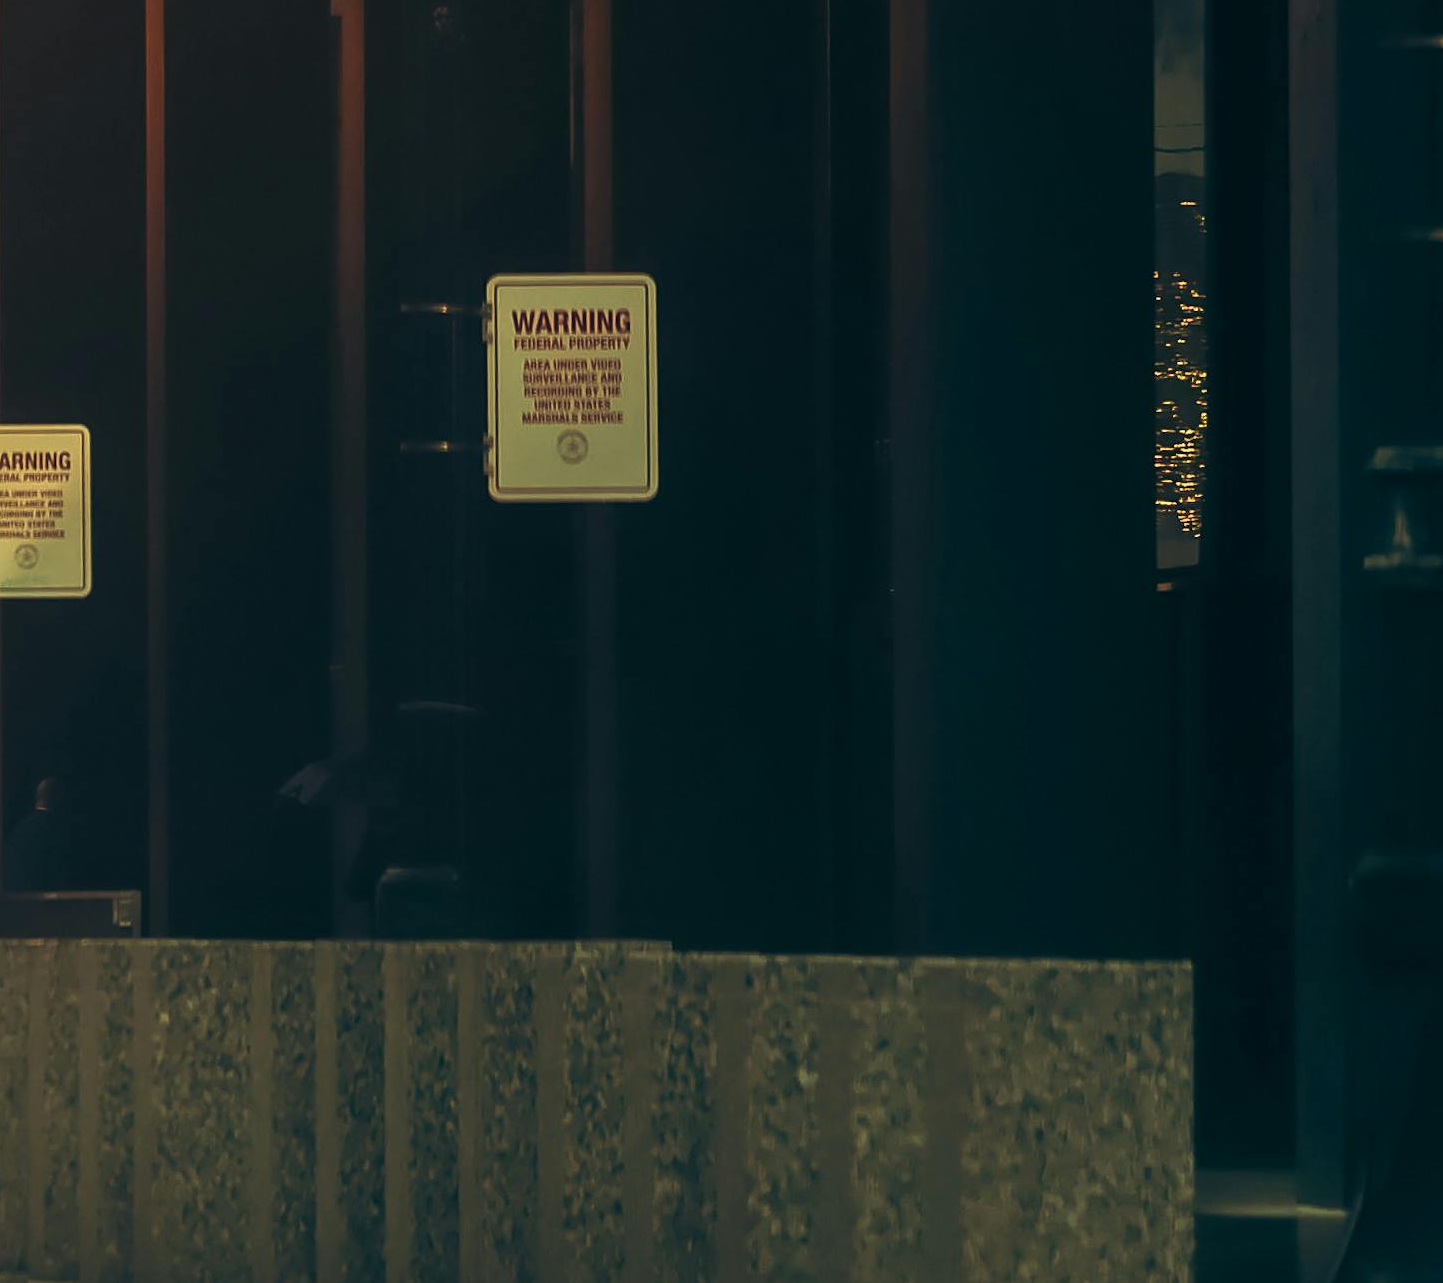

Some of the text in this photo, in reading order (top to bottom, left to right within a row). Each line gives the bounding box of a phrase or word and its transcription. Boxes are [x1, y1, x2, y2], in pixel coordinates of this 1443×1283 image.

[512, 308, 631, 335] WARNING
[514, 337, 631, 350] FEDERAL PROPERTY
[524, 358, 551, 370] AREA
[554, 358, 588, 370] UNDER
